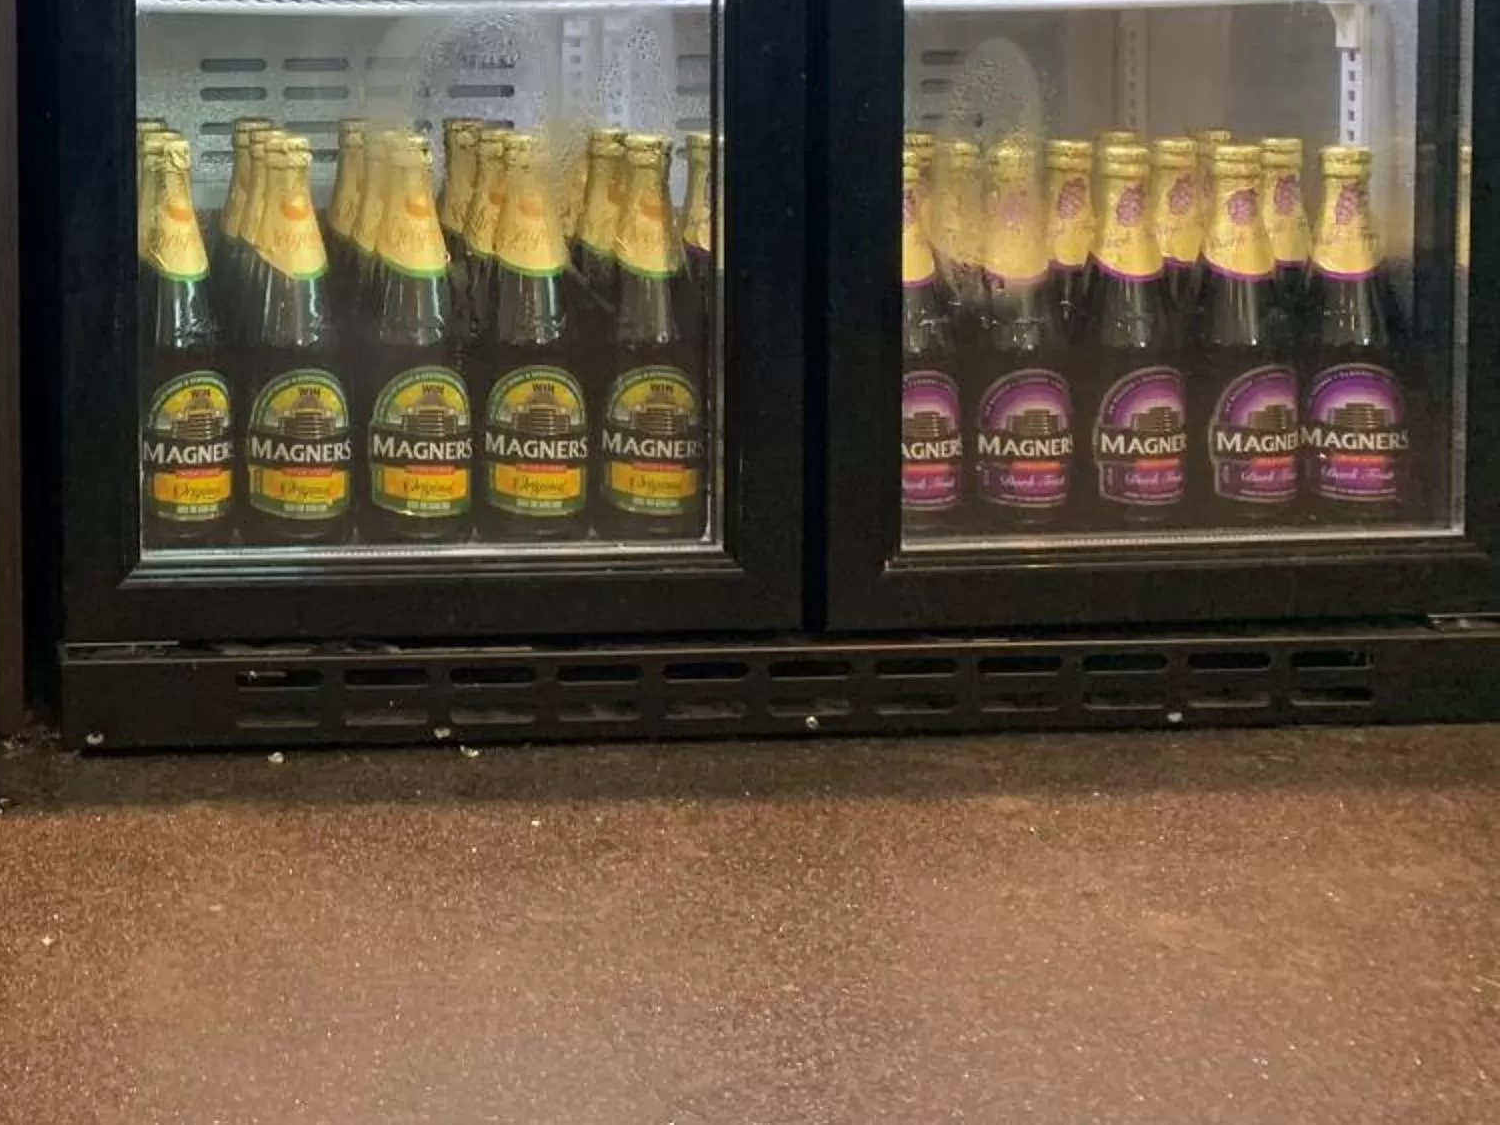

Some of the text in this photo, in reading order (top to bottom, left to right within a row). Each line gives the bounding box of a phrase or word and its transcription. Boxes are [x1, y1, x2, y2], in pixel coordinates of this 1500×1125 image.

[251, 436, 351, 463] MAGNERS
[373, 434, 472, 461] MAGNERS
[485, 431, 589, 459] MAGNERS
[1216, 430, 1299, 454] MAGNE
[1300, 426, 1409, 451] MAGNERS
